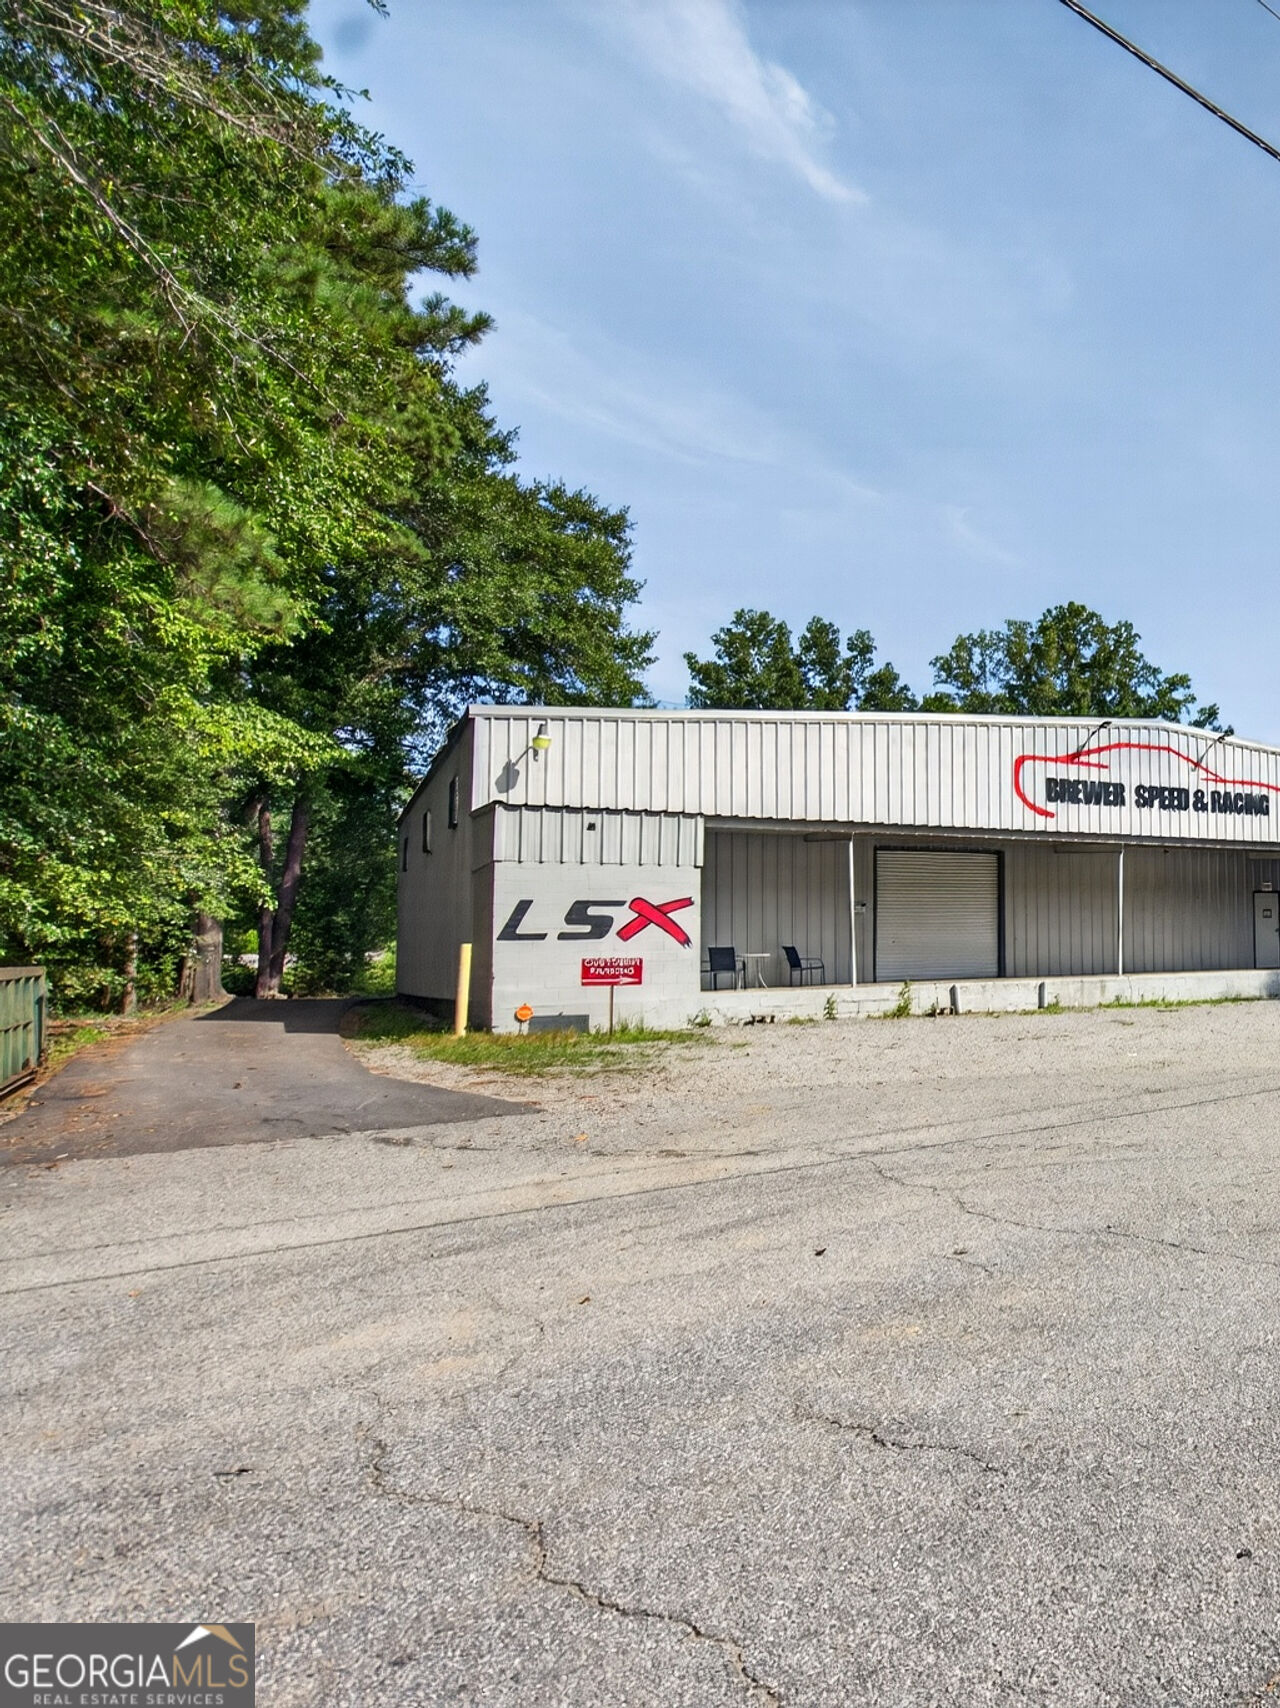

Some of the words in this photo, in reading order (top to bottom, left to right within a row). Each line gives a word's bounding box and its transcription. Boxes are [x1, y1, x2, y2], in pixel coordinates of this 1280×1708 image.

[1045, 777, 1126, 807] BREWER
[1135, 784, 1189, 812] SPEED
[1193, 789, 1209, 812] &
[1211, 790, 1270, 816] RACING
[496, 897, 695, 948] LSX
